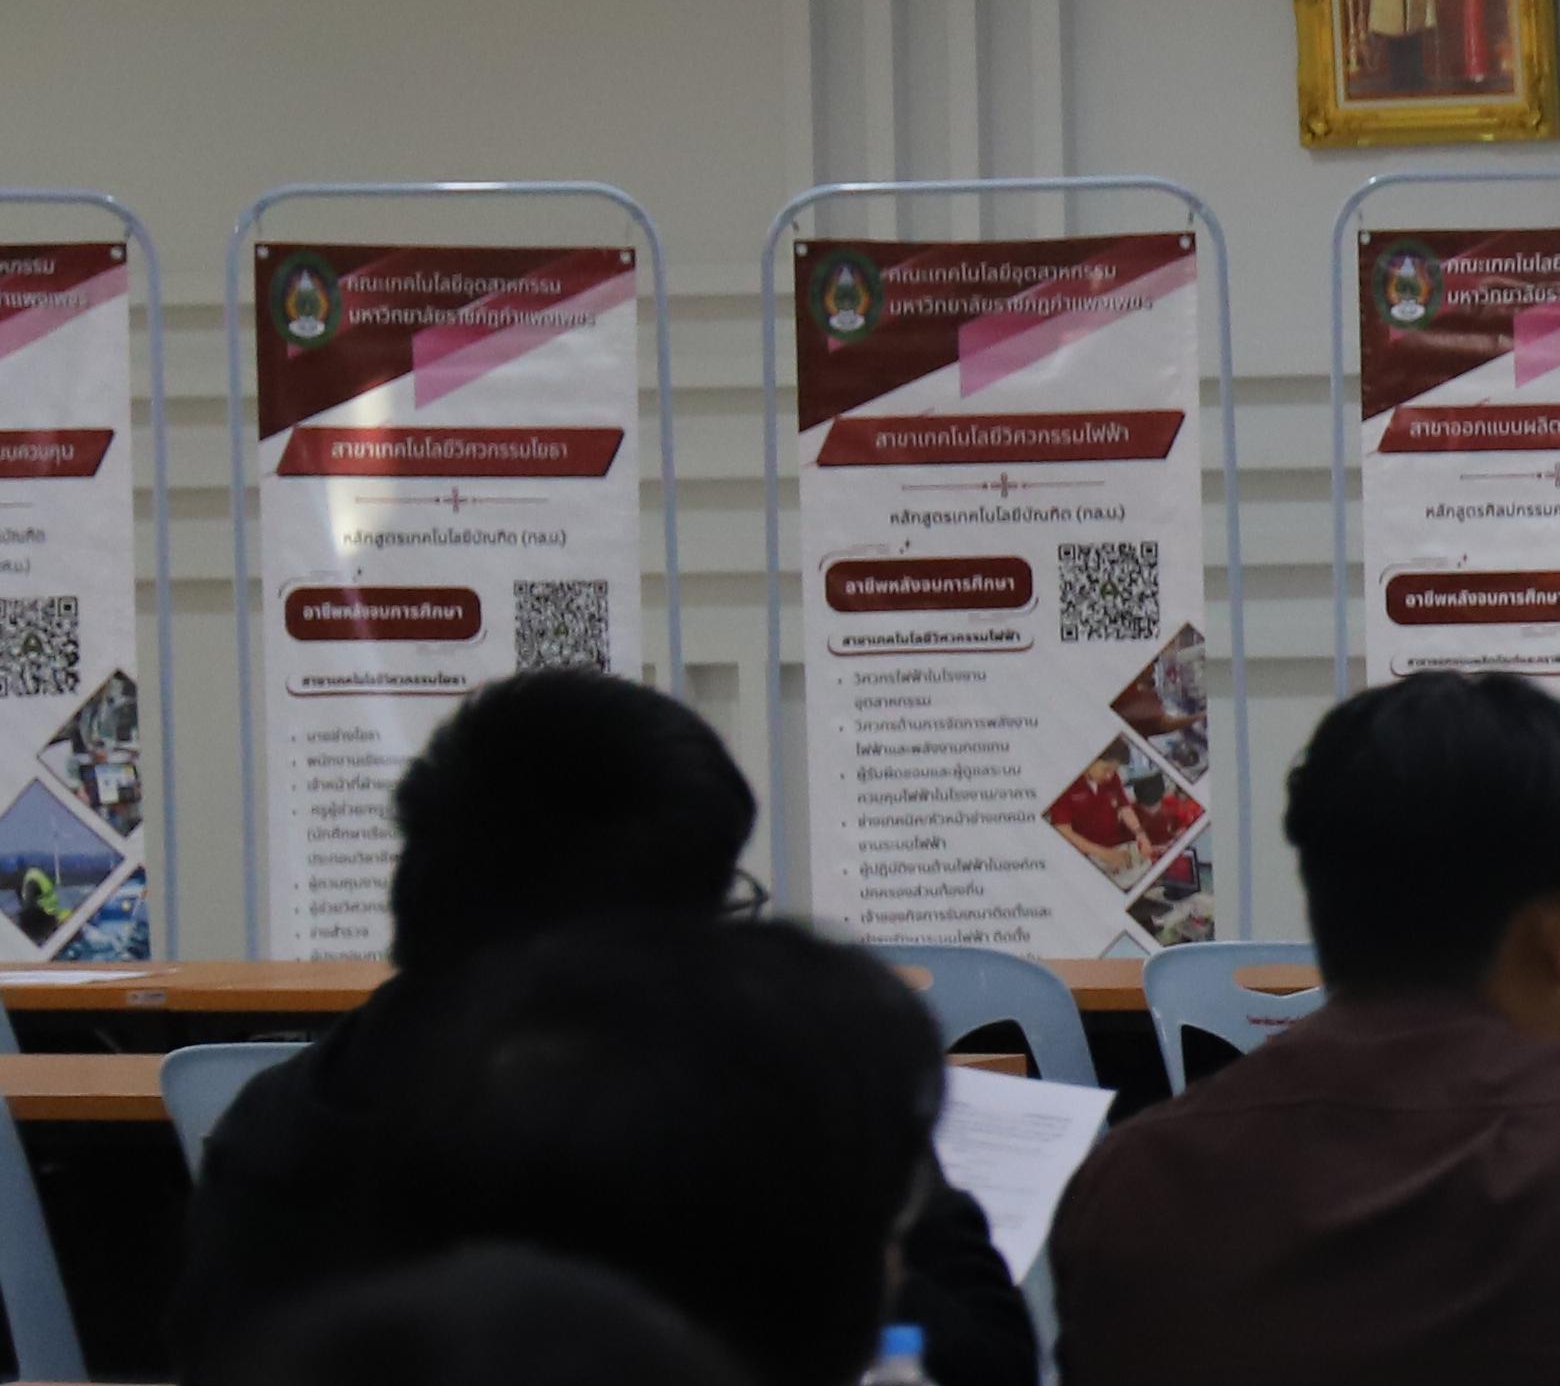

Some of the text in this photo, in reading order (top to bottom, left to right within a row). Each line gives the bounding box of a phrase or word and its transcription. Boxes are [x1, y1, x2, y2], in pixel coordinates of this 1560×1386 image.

[887, 261, 1117, 285] คณะเทคโนโลยีอุตสาหกรรม
[875, 424, 1130, 449] สาขาเทคโนโลยีวิศวกรรมไฟฟ้า
[331, 438, 569, 465] สาขาเทคโนโลยีวิศวกรรมโยธา
[845, 574, 1016, 596] อาชีพหลังจบการศึกษา
